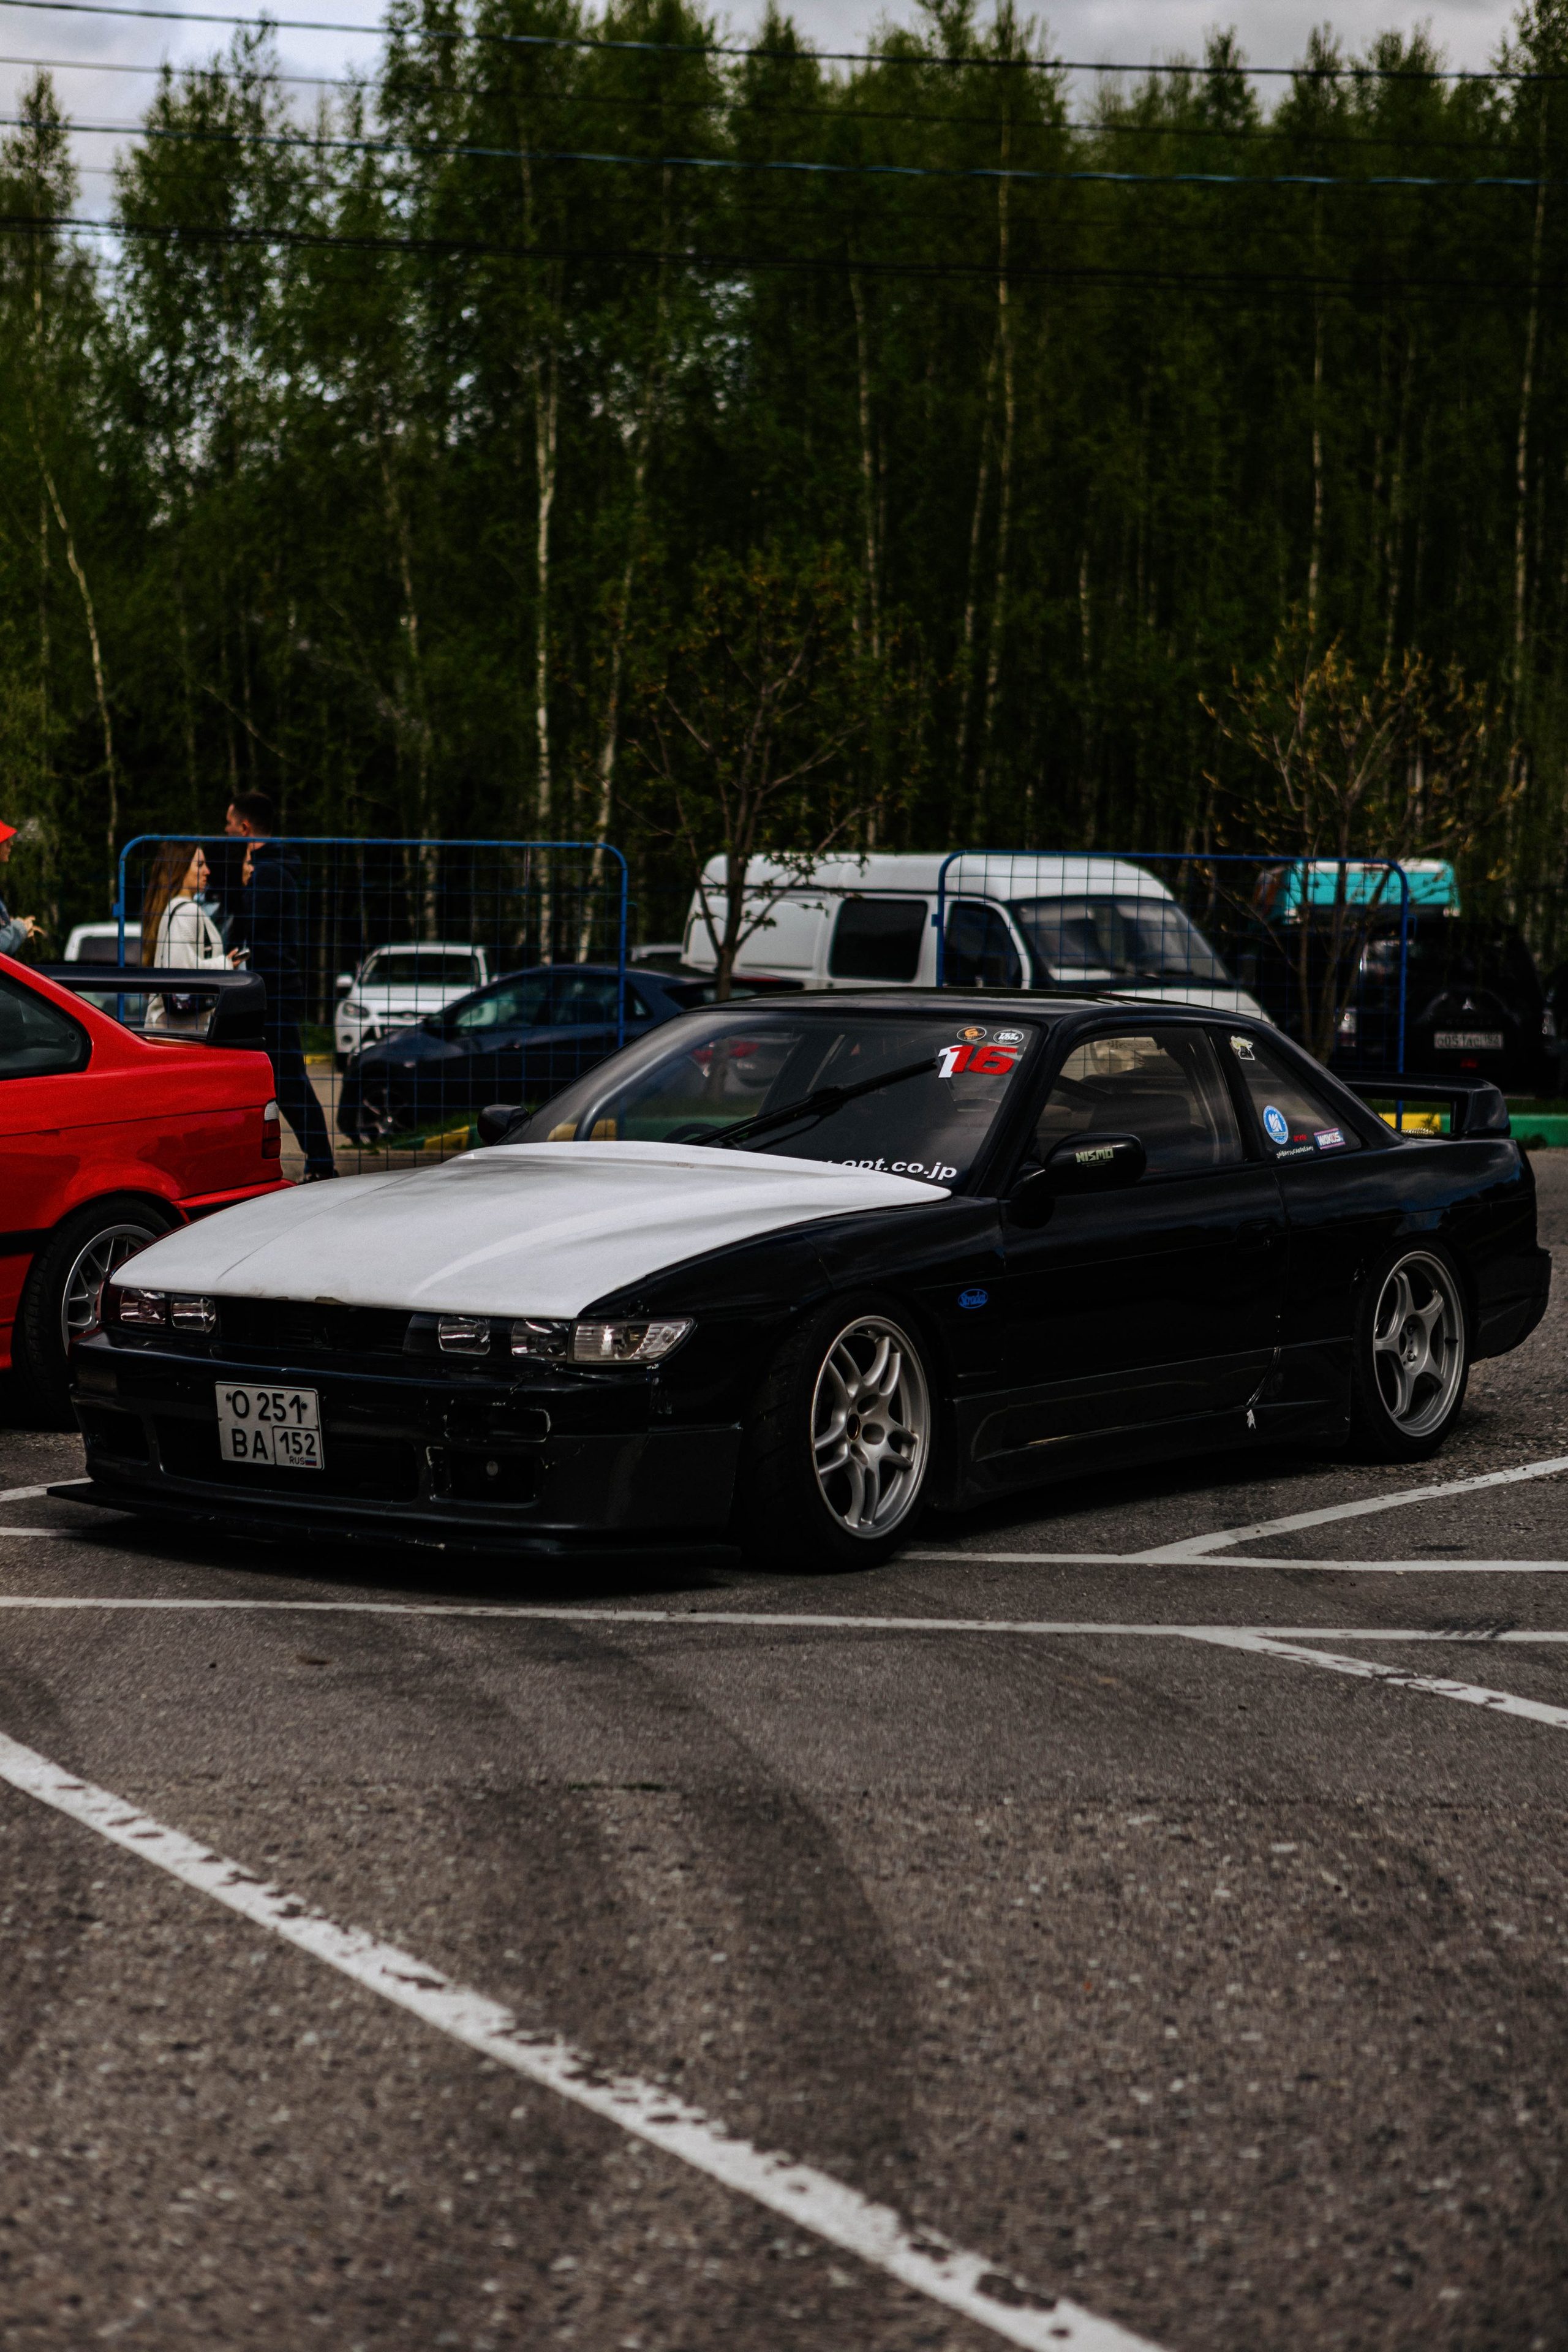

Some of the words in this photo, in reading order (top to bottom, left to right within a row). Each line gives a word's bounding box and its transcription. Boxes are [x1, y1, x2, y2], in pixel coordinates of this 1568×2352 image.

[1076, 1148, 1114, 1163] NISMO
[257, 1392, 302, 1424] 251
[232, 1428, 269, 1460] BA
[279, 1431, 316, 1457] 152
[289, 1456, 305, 1465] RUS
